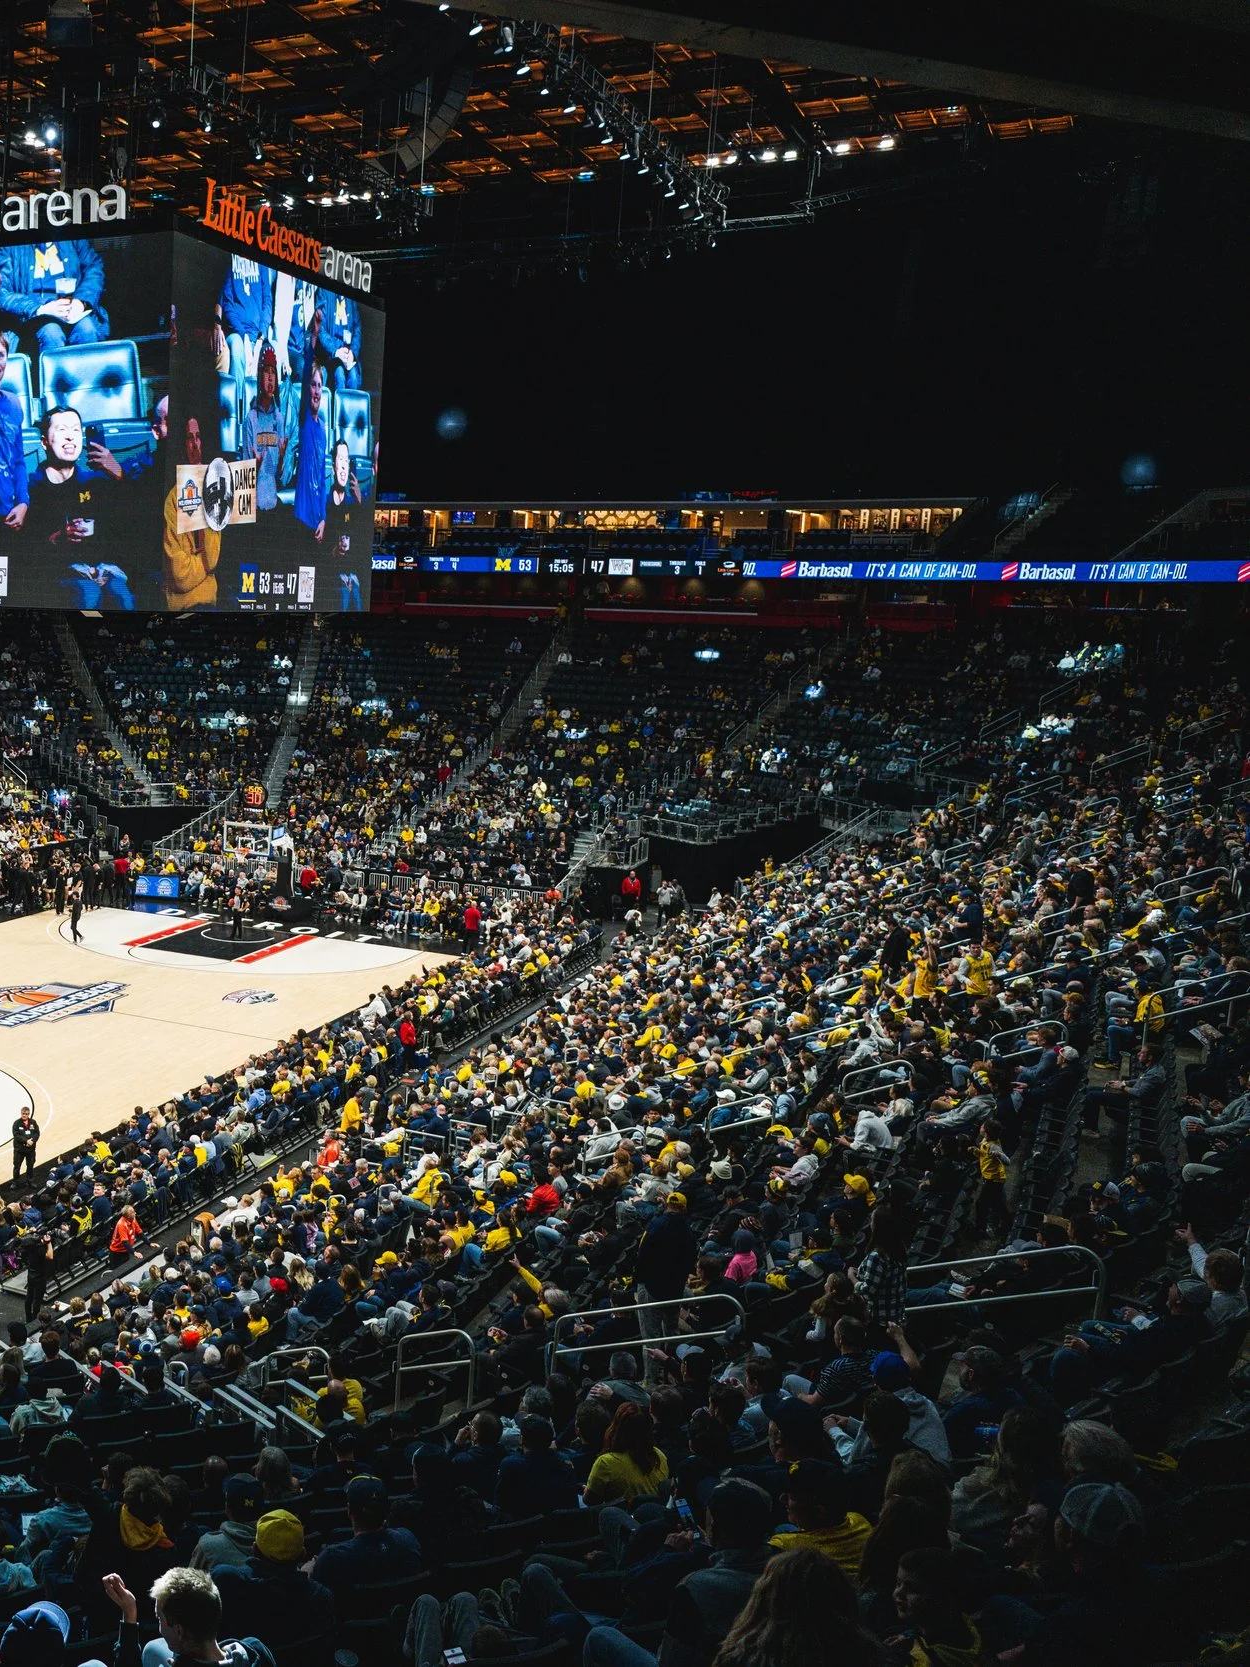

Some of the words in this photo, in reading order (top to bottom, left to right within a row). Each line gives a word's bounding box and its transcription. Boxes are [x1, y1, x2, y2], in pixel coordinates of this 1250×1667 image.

[3, 184, 126, 231] arena
[203, 177, 254, 245] Little
[256, 205, 322, 273] Caesars
[324, 247, 372, 293] arena
[235, 467, 255, 490] DANCE
[238, 494, 251, 515] CAM
[434, 562, 439, 570] 3
[452, 562, 457, 570] 4
[495, 558, 511, 571] M
[519, 560, 531, 571] 53
[549, 563, 574, 573] 15:05
[591, 560, 604, 573] 47
[674, 566, 680, 575] 3
[698, 566, 702, 575] 1
[798, 561, 852, 577] Barbasol
[865, 563, 885, 577] IT'S
[888, 564, 895, 577] A
[900, 563, 921, 578] CAN
[924, 564, 937, 577] OF
[938, 563, 977, 578] CAN-DO.
[1019, 562, 1075, 580] Barbasol
[1089, 564, 1108, 579] IT'S
[1109, 564, 1115, 579] A
[1118, 564, 1135, 579] CAN
[1137, 564, 1149, 579] OF
[1151, 563, 1188, 579] CAN-DO.
[242, 572, 255, 593] M
[259, 572, 270, 594] 53
[287, 573, 297, 594] 47
[247, 792, 261, 805] 30
